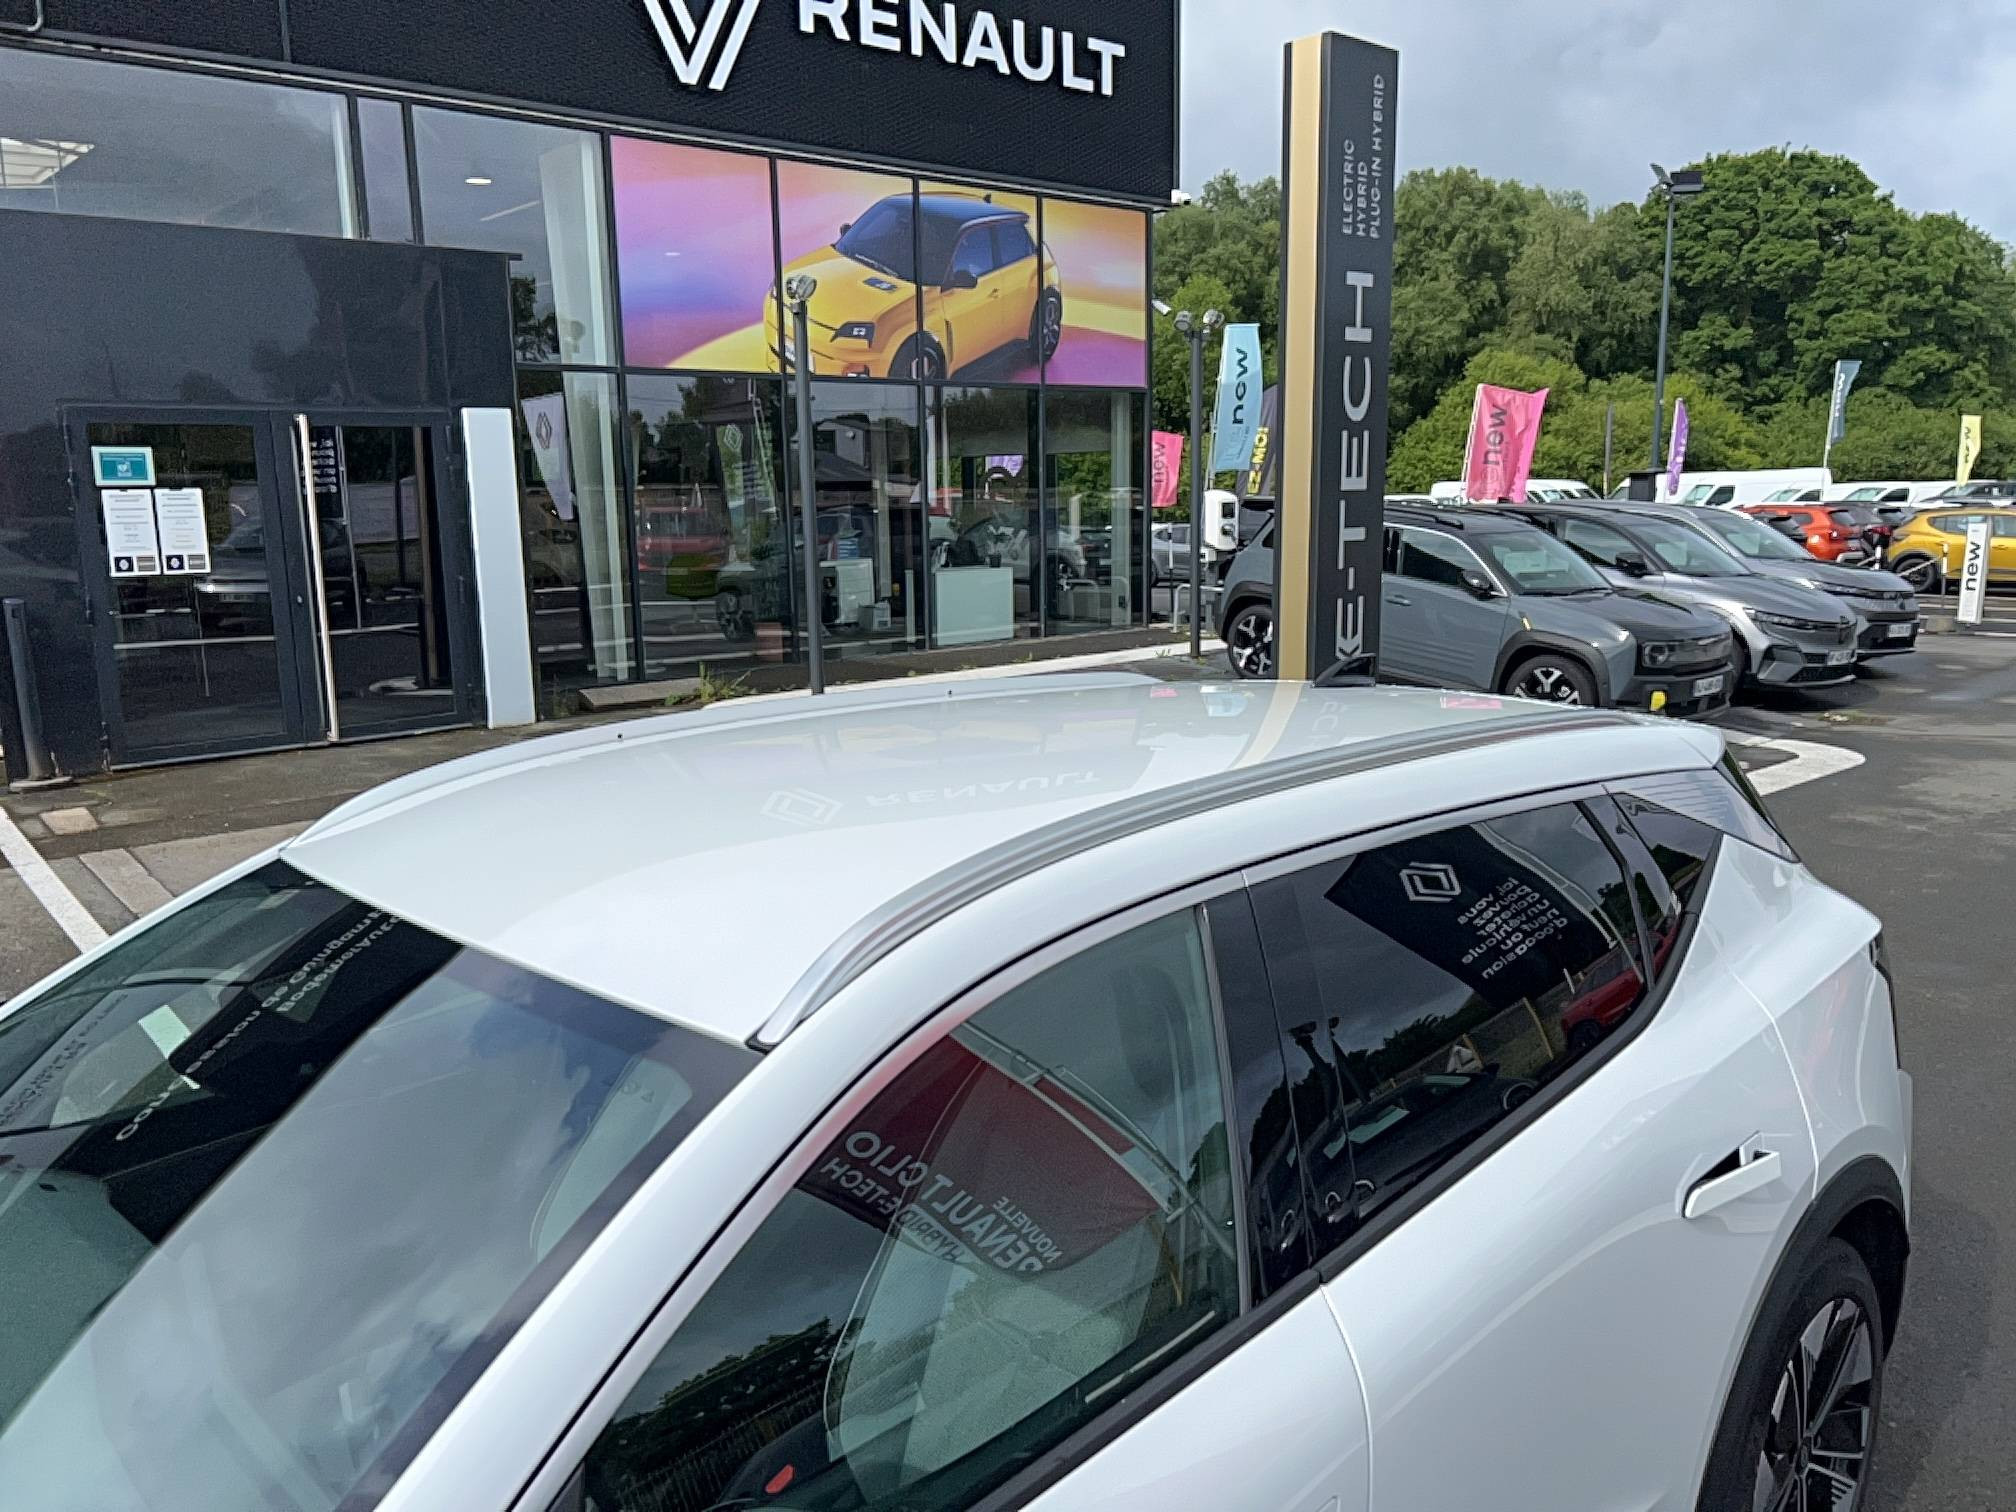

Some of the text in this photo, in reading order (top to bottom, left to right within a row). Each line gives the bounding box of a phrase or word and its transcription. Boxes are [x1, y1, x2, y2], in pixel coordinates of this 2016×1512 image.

[798, 0, 1126, 96] RENAULT
[1343, 139, 1356, 236] ELECTRIC
[1356, 160, 1368, 238] HYBRID
[1370, 74, 1386, 239] PLUG-IN HYBRID
[1335, 270, 1374, 658] E-TECH
